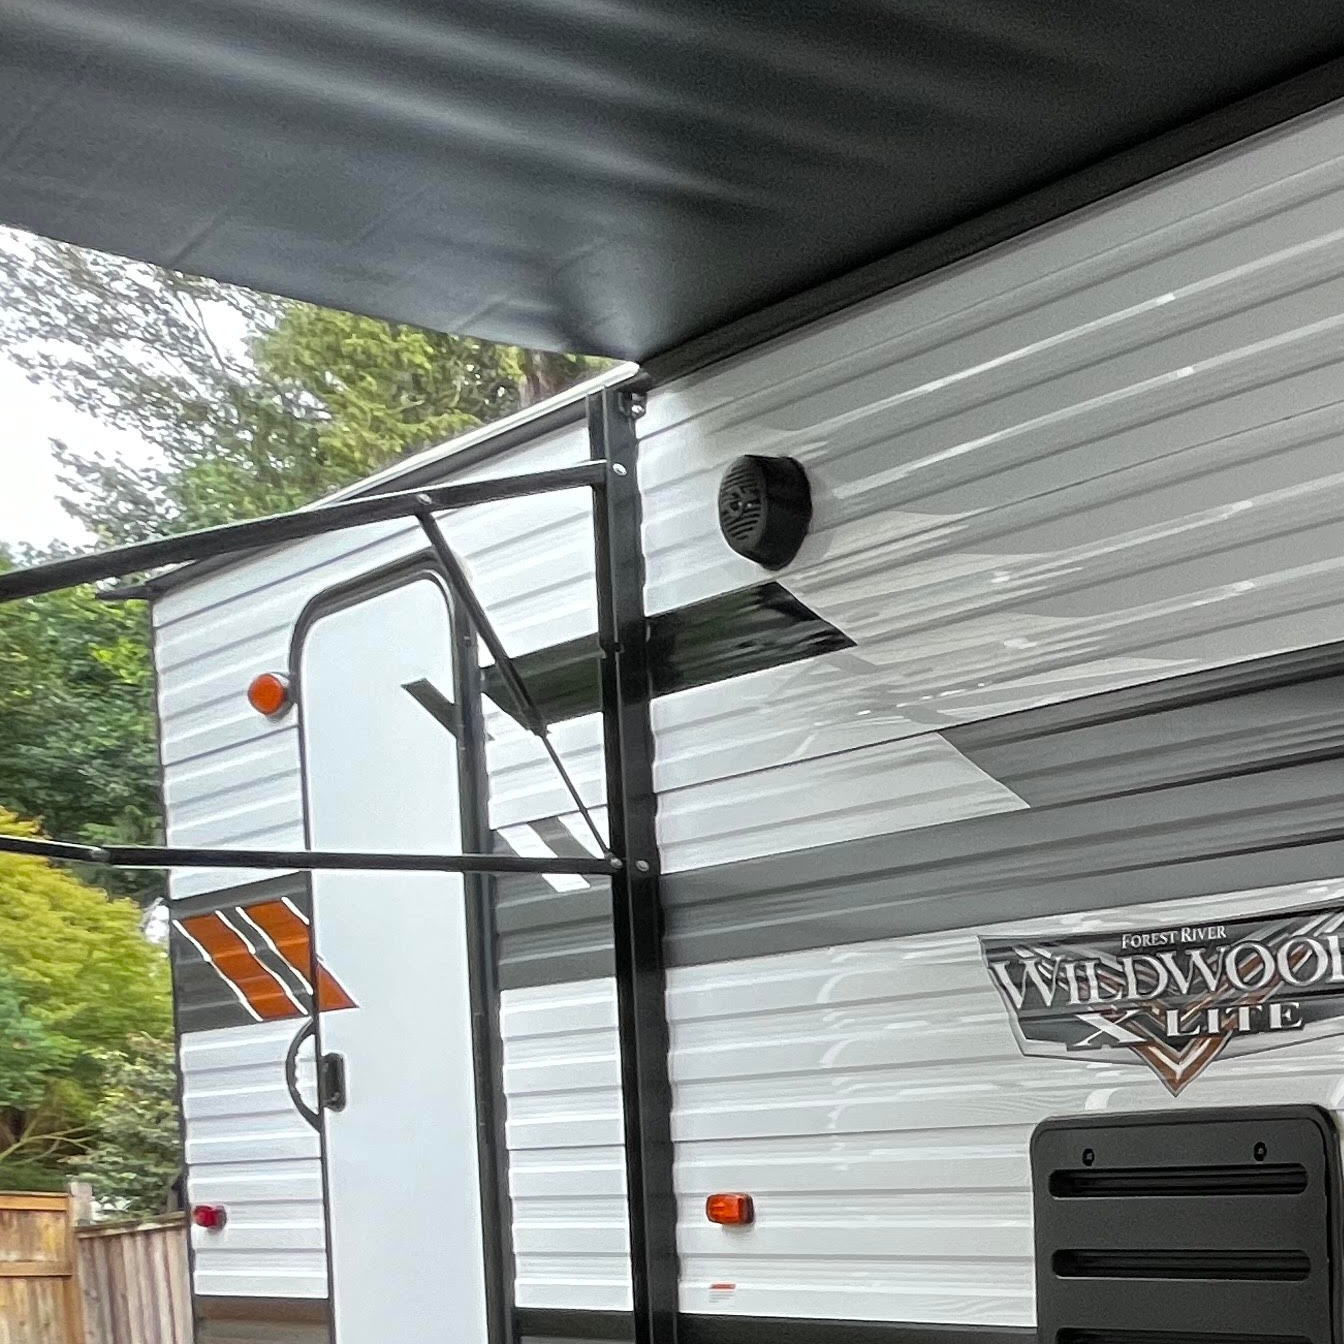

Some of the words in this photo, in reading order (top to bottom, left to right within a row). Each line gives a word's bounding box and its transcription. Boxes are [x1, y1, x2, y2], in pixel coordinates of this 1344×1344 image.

[1121, 931, 1178, 950] FOREST
[1180, 924, 1227, 943] RIVER
[1073, 1008, 1148, 1047] X
[1166, 1002, 1303, 1037] LITE
